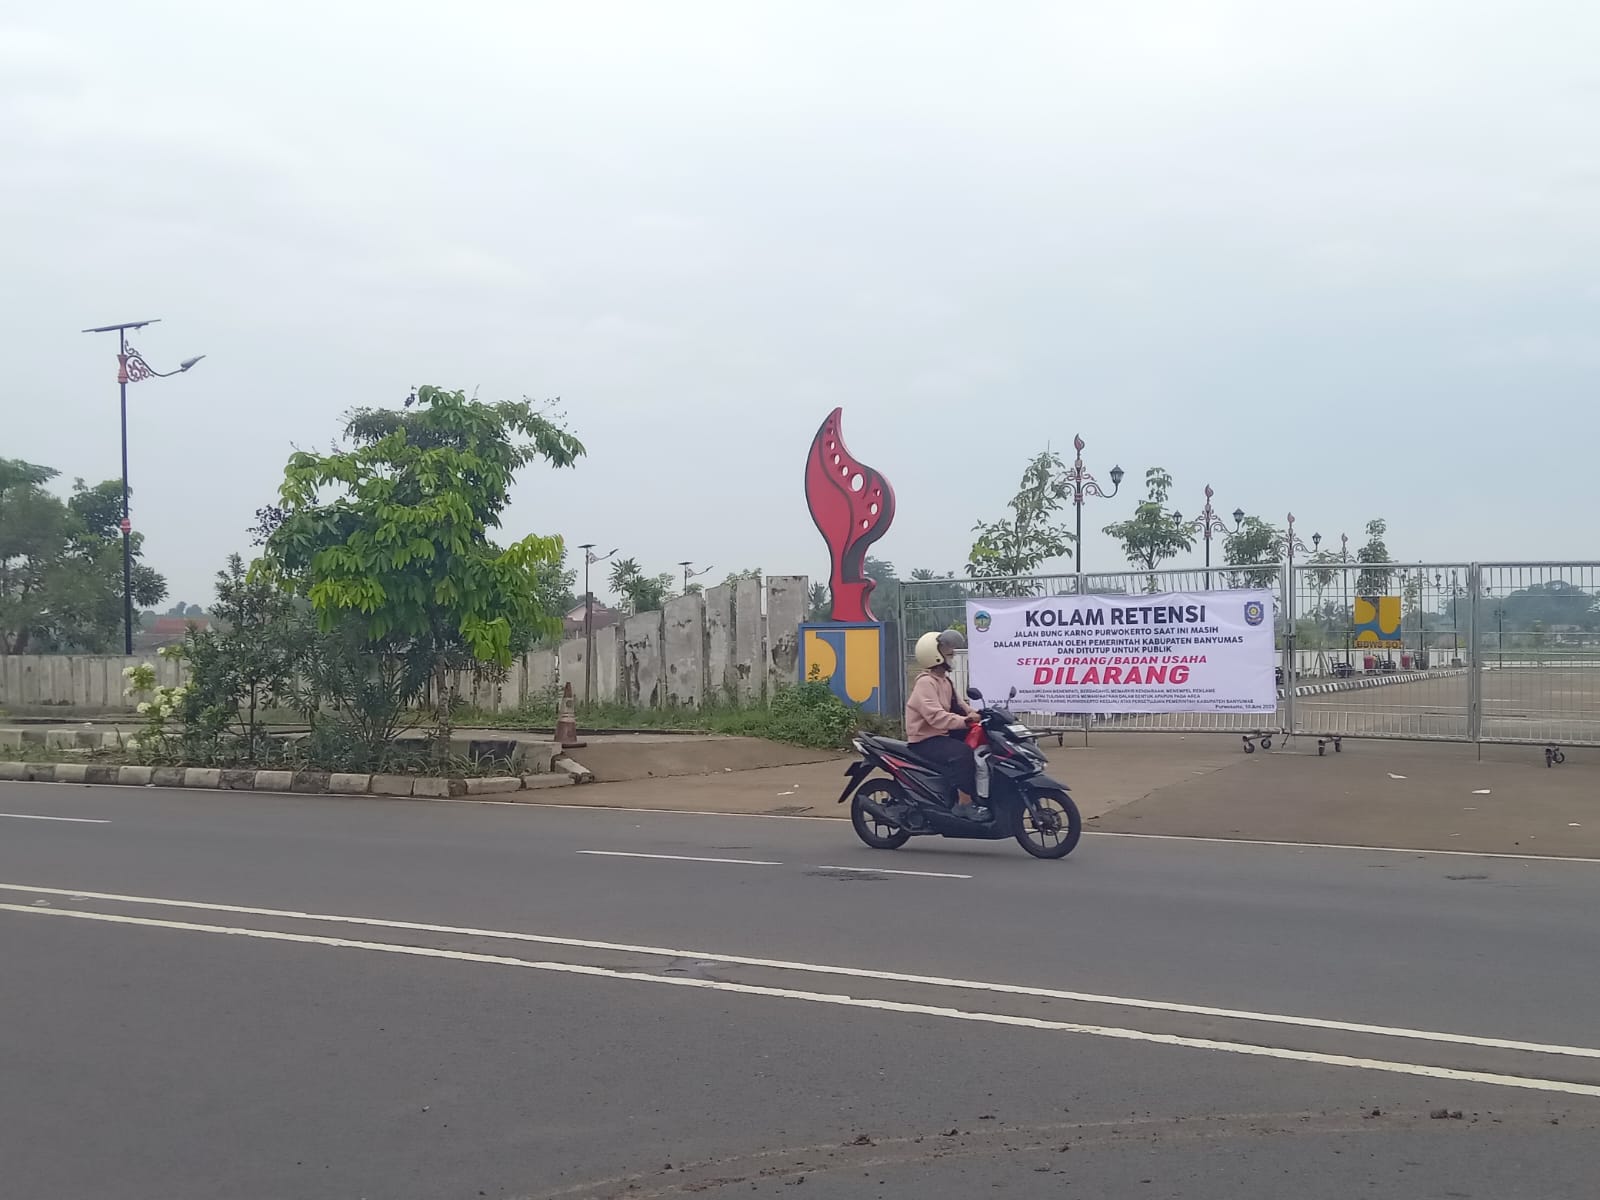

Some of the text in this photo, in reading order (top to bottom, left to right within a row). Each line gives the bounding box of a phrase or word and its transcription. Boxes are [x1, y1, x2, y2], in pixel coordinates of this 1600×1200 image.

[1025, 606, 1206, 627] KOLAM RETENSI
[1095, 628, 1152, 636] PURWOKERTO
[1022, 639, 1063, 647] PENATAAN
[1089, 638, 1140, 646] PEMERINTAH
[1142, 637, 1192, 645] KABUPATEN
[1194, 636, 1243, 644] BANYUMAS
[1076, 646, 1110, 654] DITUTUP
[1142, 645, 1172, 653] PUBLIK
[1017, 656, 1207, 665] SETIAP ORANG/BADAN USAHA
[1033, 666, 1190, 685] DILARANG
